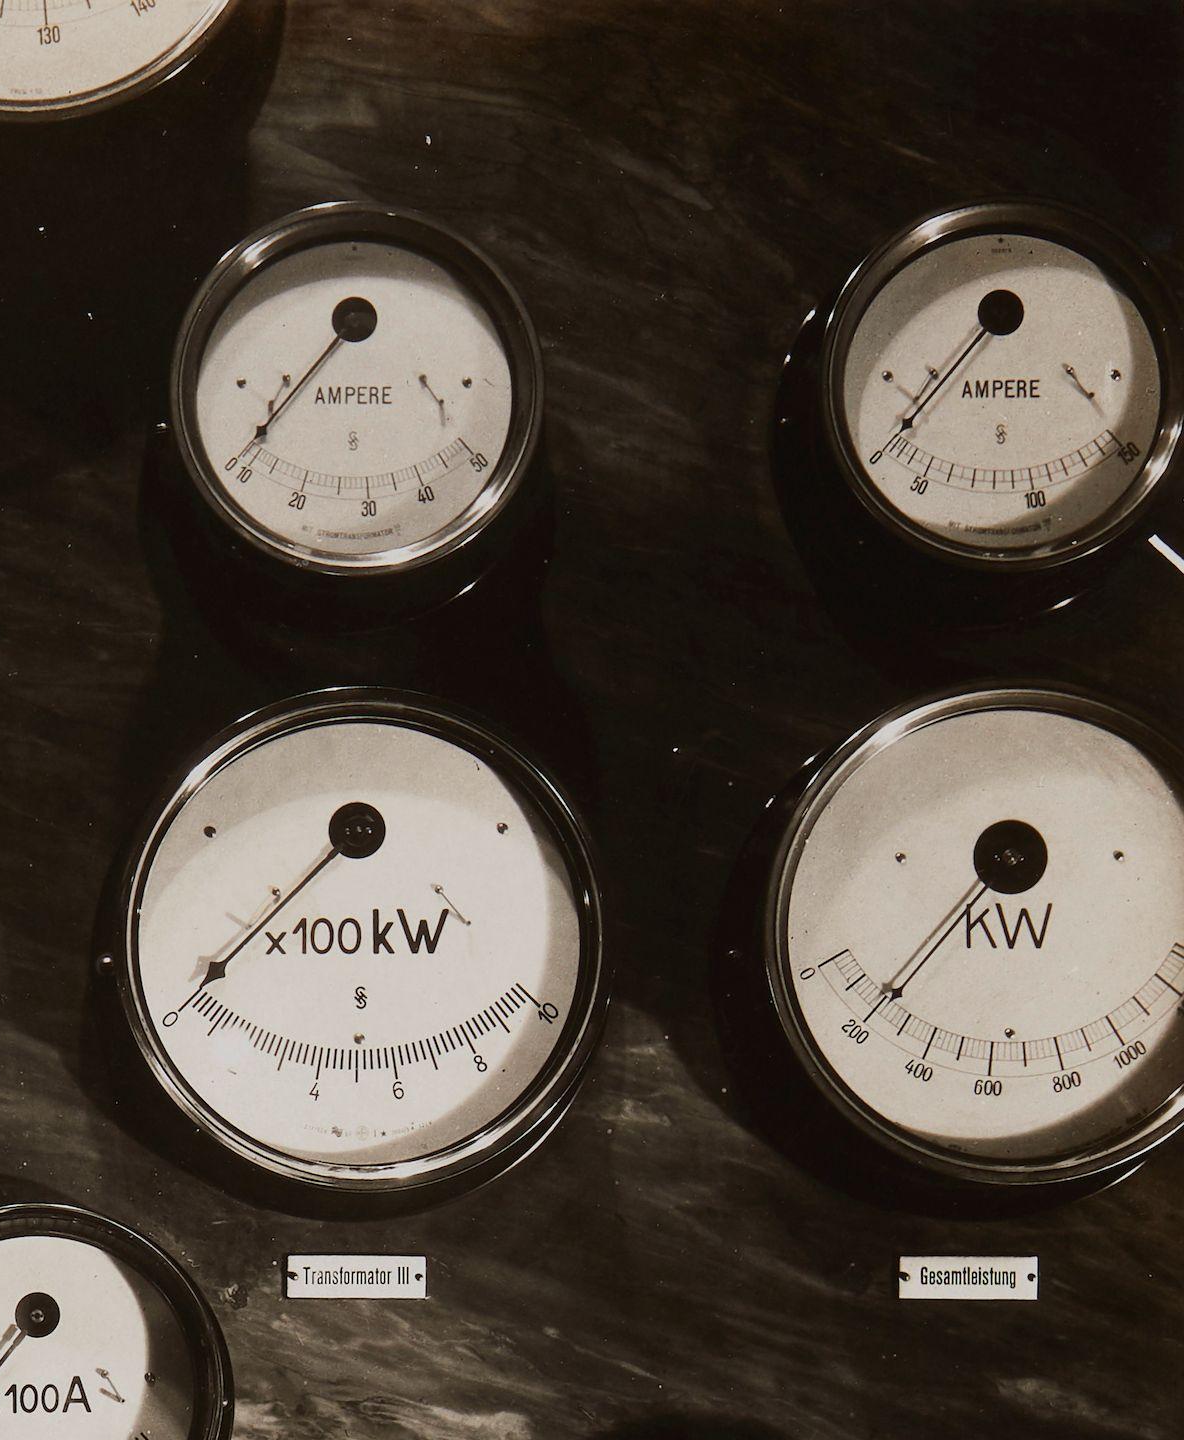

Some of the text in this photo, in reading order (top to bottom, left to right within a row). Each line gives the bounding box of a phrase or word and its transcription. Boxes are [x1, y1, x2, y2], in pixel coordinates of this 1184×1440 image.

[36, 26, 61, 46] 130
[314, 386, 393, 405] AMPERE
[961, 379, 1040, 399] AMPERE
[225, 453, 489, 517] 0 10 20 30 40 50
[869, 443, 1141, 509] 0 50 100 150
[799, 966, 1148, 1097] 0 200 400 600 800 1000
[162, 1002, 560, 1101] 0 4 6 8 10
[303, 1266, 410, 1285] Transformator III
[920, 1266, 1016, 1288] Gesamtleistung
